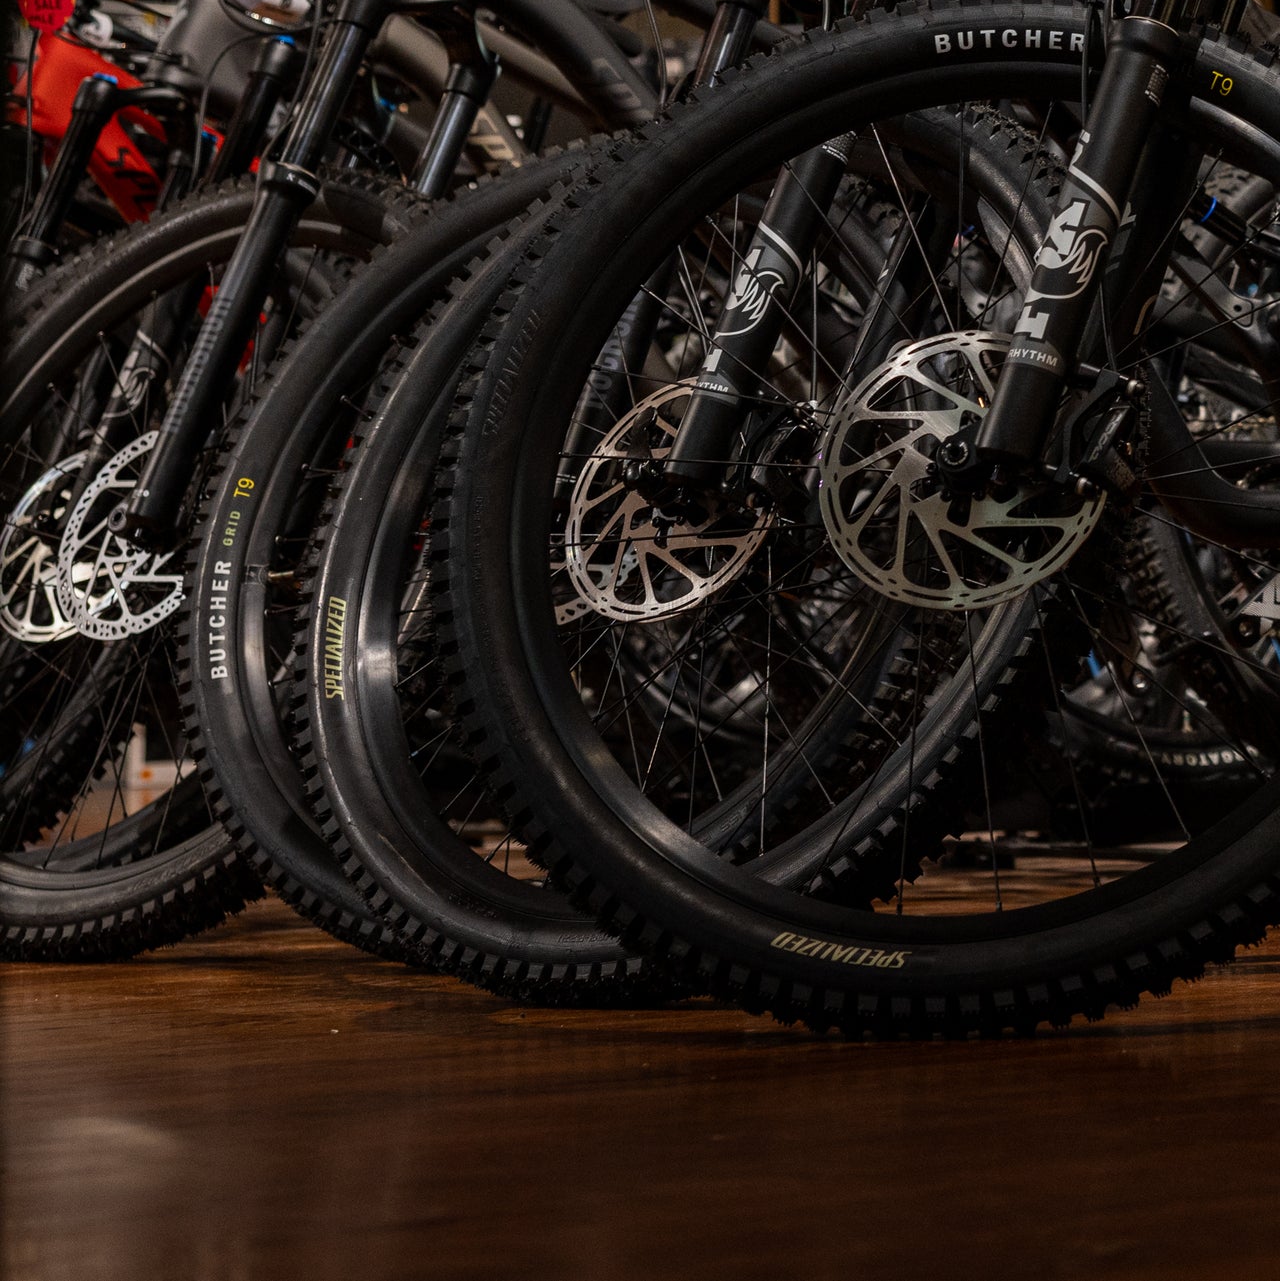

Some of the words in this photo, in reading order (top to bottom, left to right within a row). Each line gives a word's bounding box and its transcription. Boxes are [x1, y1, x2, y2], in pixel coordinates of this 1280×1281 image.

[934, 28, 1086, 55] BUTCHER
[1209, 70, 1234, 97] T9
[1008, 347, 1058, 368] RHYTHM
[209, 560, 232, 680] BUTCHER
[222, 511, 241, 547] GRID
[233, 477, 255, 499] T9
[324, 596, 348, 701] SPECIALIZED
[770, 931, 913, 970] SPECIALIZED
